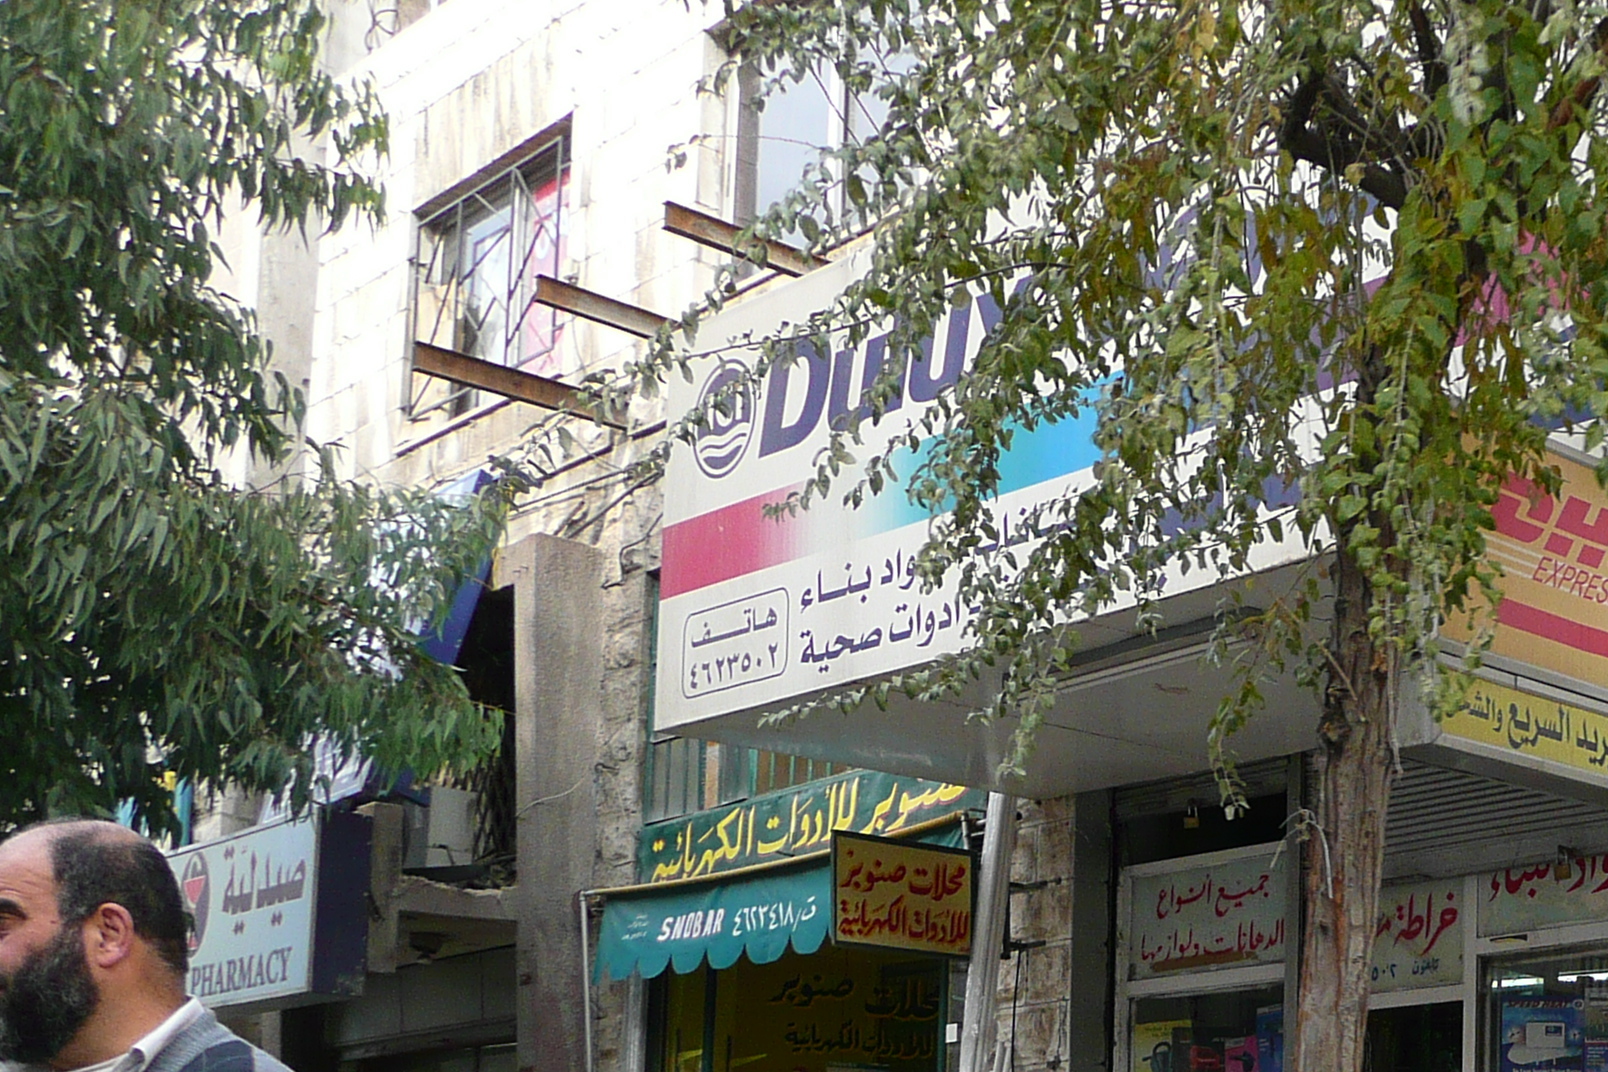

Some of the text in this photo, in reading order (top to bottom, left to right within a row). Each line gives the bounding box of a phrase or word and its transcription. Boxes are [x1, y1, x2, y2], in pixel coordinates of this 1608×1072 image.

[799, 547, 920, 615] واد بناء
[691, 606, 778, 649] هاتف
[799, 624, 883, 674] صحية
[689, 642, 779, 690] ٤٦٢٣٥٠٢
[1508, 702, 1571, 750] السريع
[651, 804, 756, 884] الكهربائية
[222, 846, 306, 936] صيدلية
[840, 848, 966, 902] محلات صنوبر
[1215, 873, 1271, 917] جميع
[656, 908, 725, 943] SNOBAR
[190, 946, 293, 996] PHARMACY
